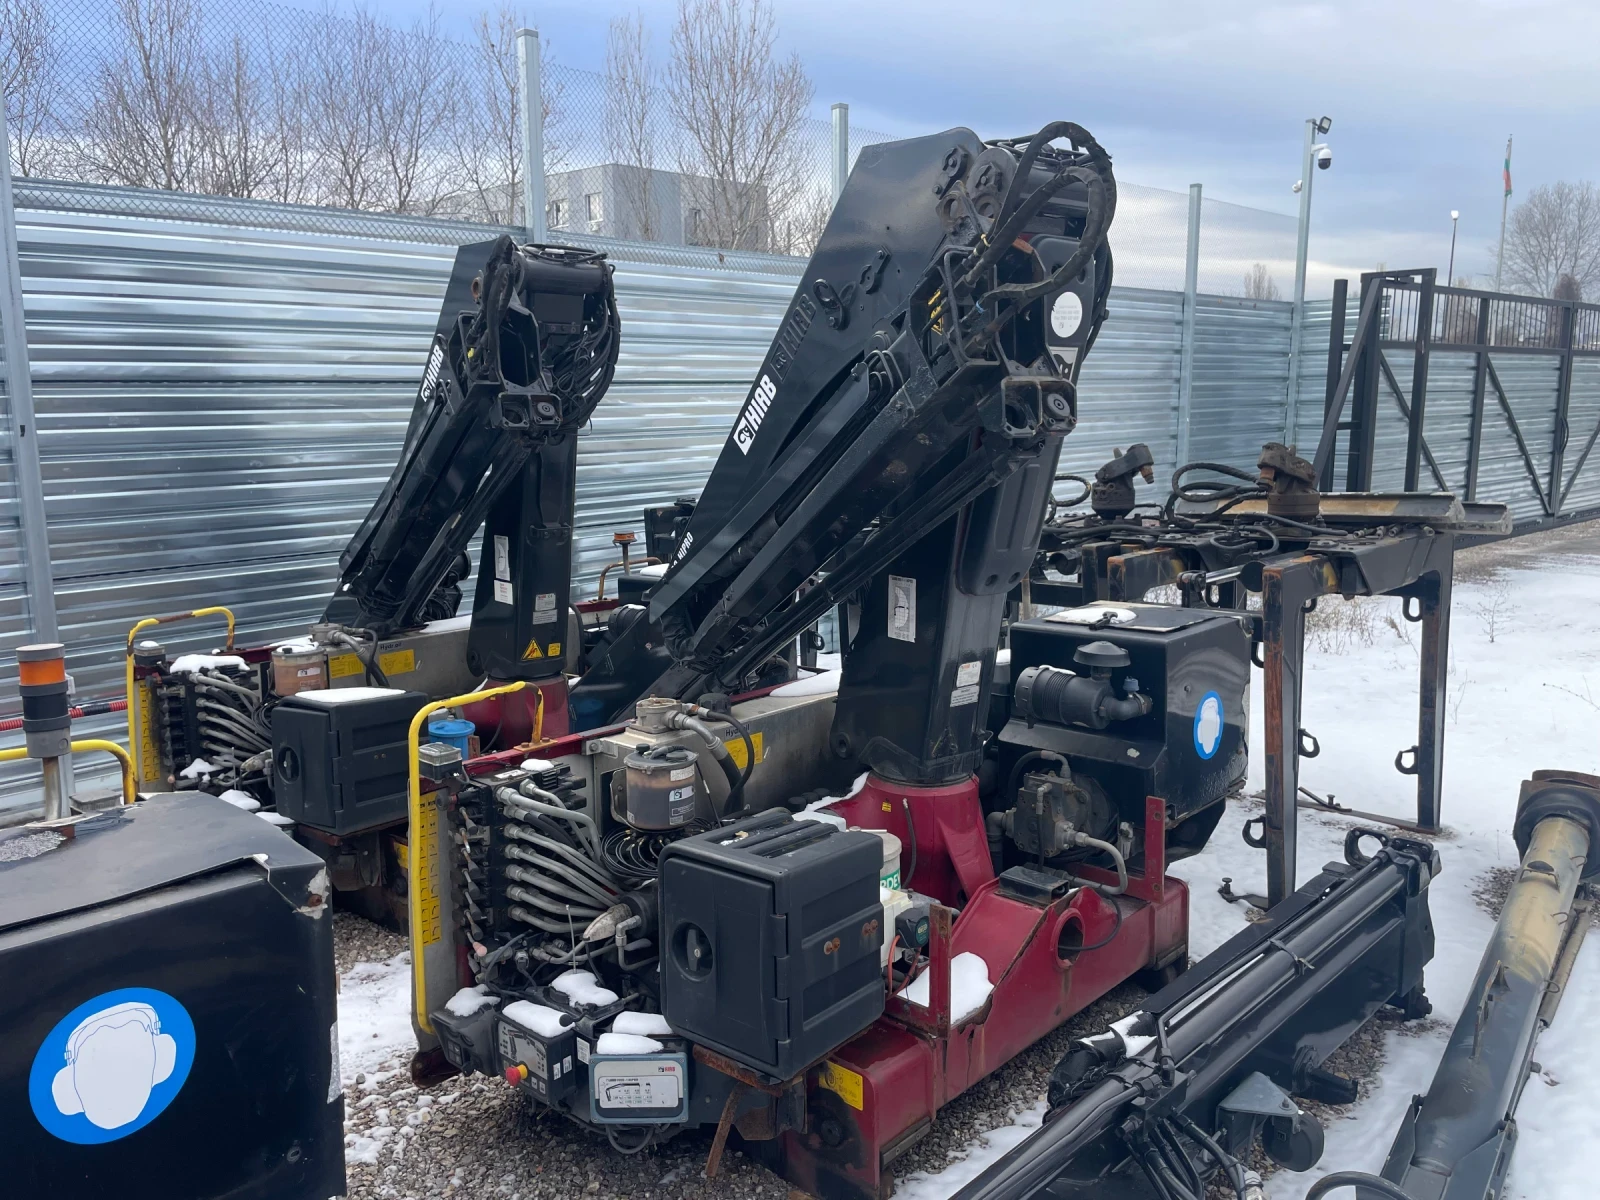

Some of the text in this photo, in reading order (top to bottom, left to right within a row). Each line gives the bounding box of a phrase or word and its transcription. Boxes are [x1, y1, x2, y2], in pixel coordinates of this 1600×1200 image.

[779, 293, 817, 360] HIAB
[426, 344, 444, 388] HIAB
[744, 374, 777, 432] HIAB
[677, 531, 694, 560] HIPRO
